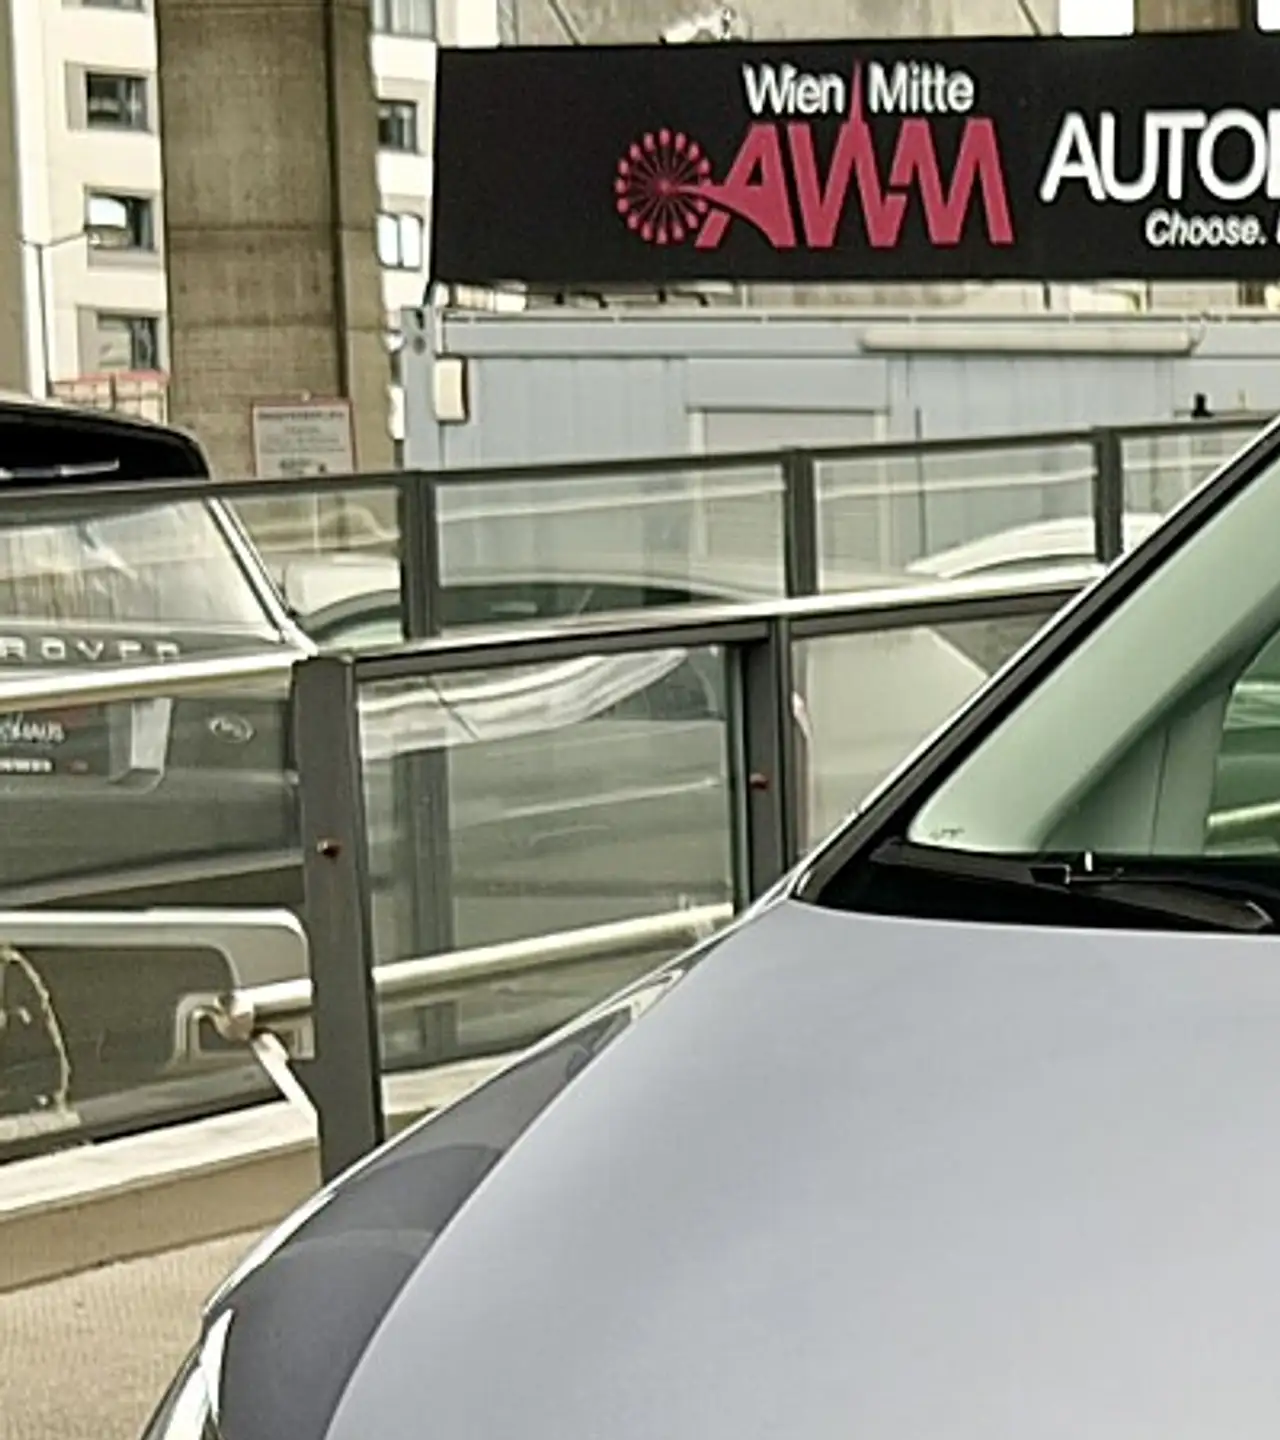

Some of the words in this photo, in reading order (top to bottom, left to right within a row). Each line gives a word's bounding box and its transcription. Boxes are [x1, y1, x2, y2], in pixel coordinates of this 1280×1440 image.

[743, 62, 844, 114] Wien
[869, 61, 975, 113] Mitte
[694, 60, 1014, 248] AWM
[1146, 208, 1267, 247] Choose.
